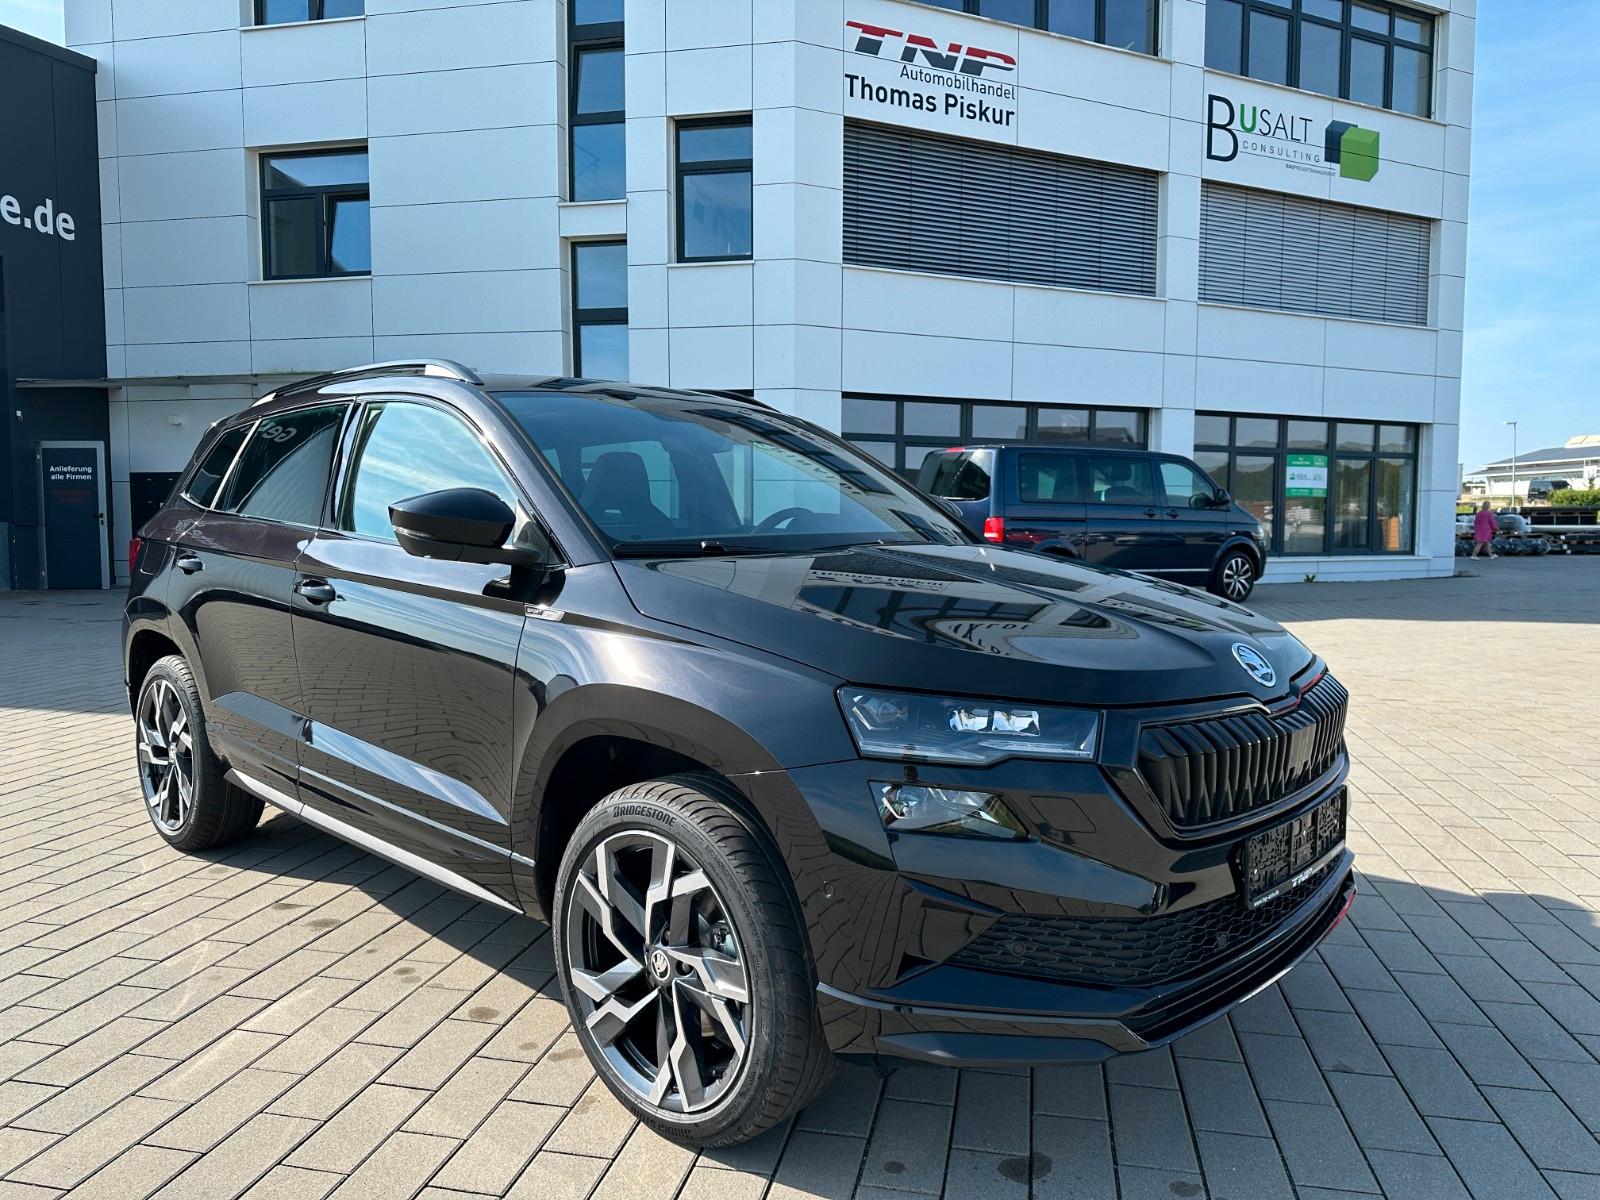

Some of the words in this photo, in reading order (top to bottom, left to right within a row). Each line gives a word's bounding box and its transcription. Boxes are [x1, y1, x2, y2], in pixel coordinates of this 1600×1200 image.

[846, 21, 1016, 76] TNP
[844, 73, 937, 112] Thomas
[944, 93, 1015, 126] Piskur
[900, 65, 1016, 100] Automobilhandel
[1206, 94, 1313, 162] BUSALT
[1242, 140, 1321, 163] CONSULTING
[0, 194, 75, 241] e.de
[613, 805, 677, 827] BRIDGESTONE
